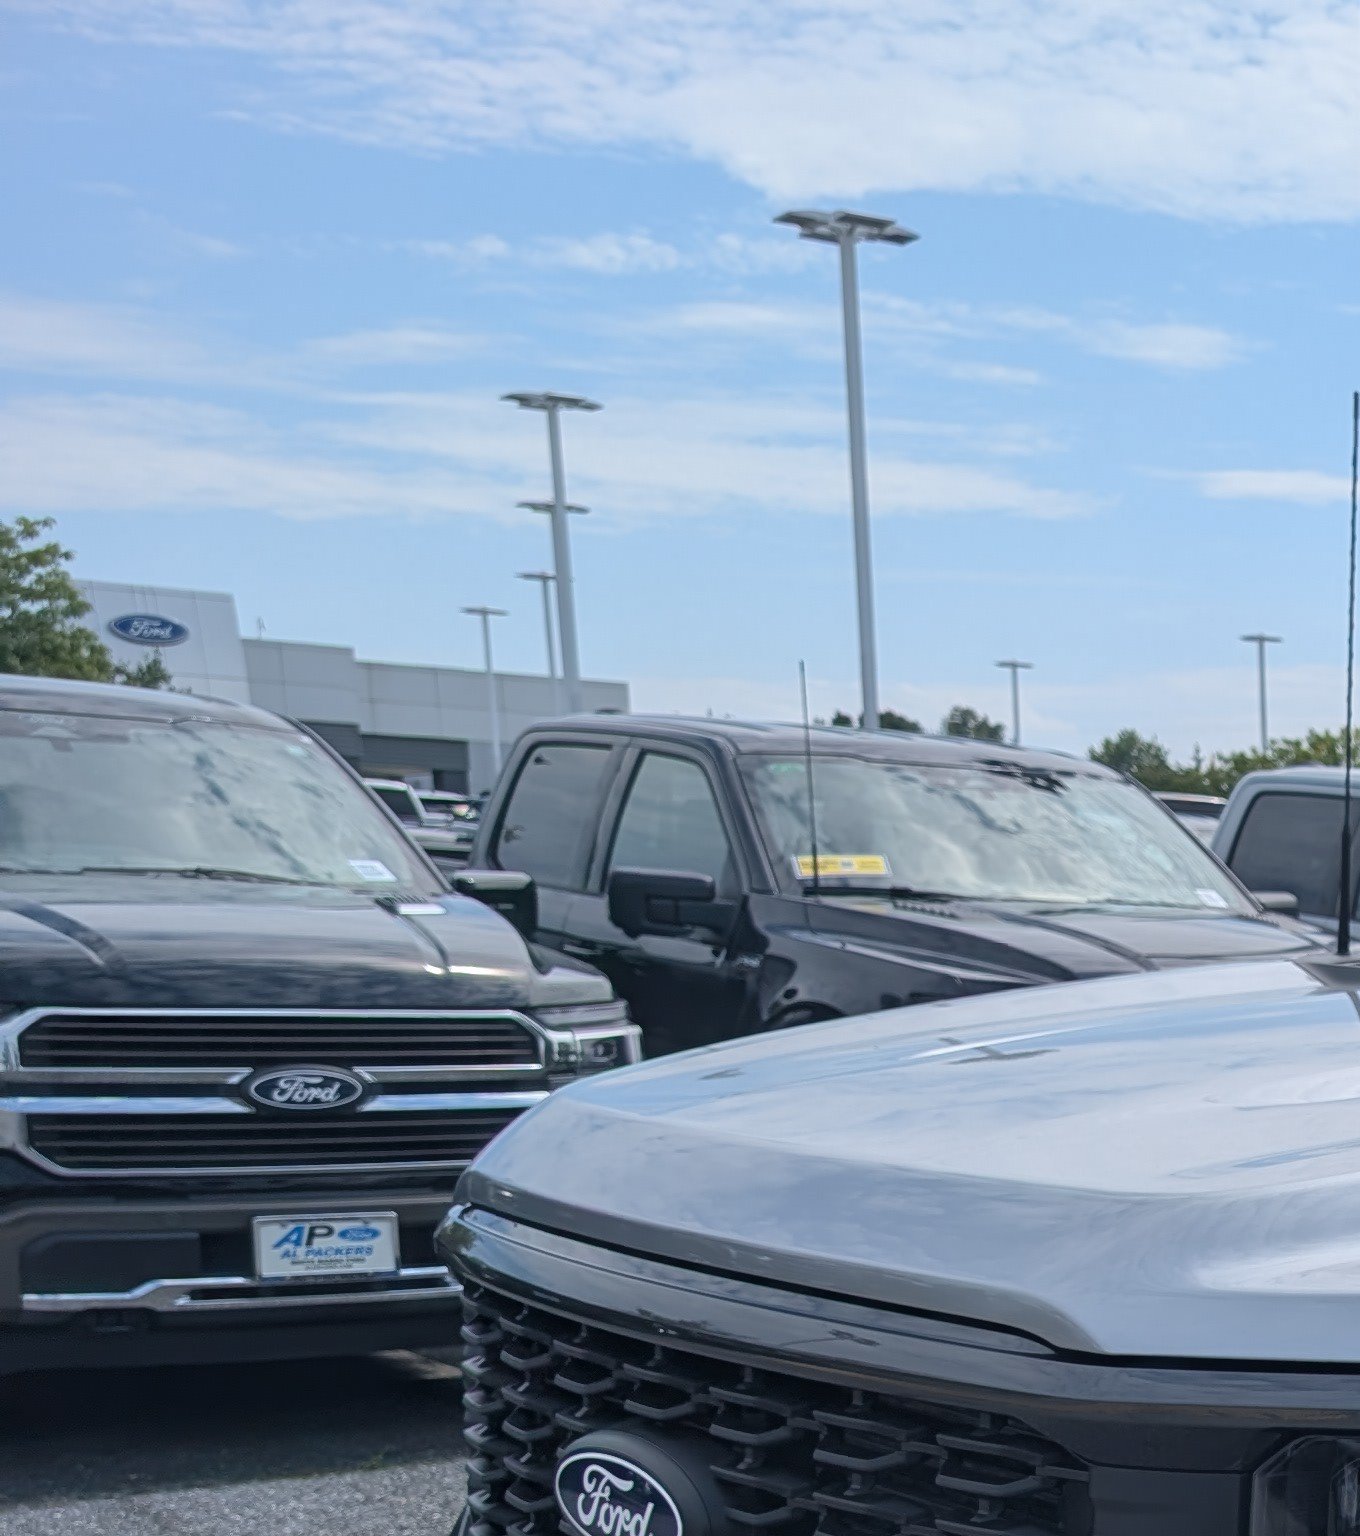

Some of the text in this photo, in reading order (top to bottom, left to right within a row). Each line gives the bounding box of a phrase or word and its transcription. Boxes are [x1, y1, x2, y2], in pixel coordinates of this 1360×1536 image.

[129, 618, 173, 639] Ford
[272, 1074, 342, 1103] Ford
[272, 1225, 334, 1250] AP
[281, 1245, 374, 1260] AL PACKERS
